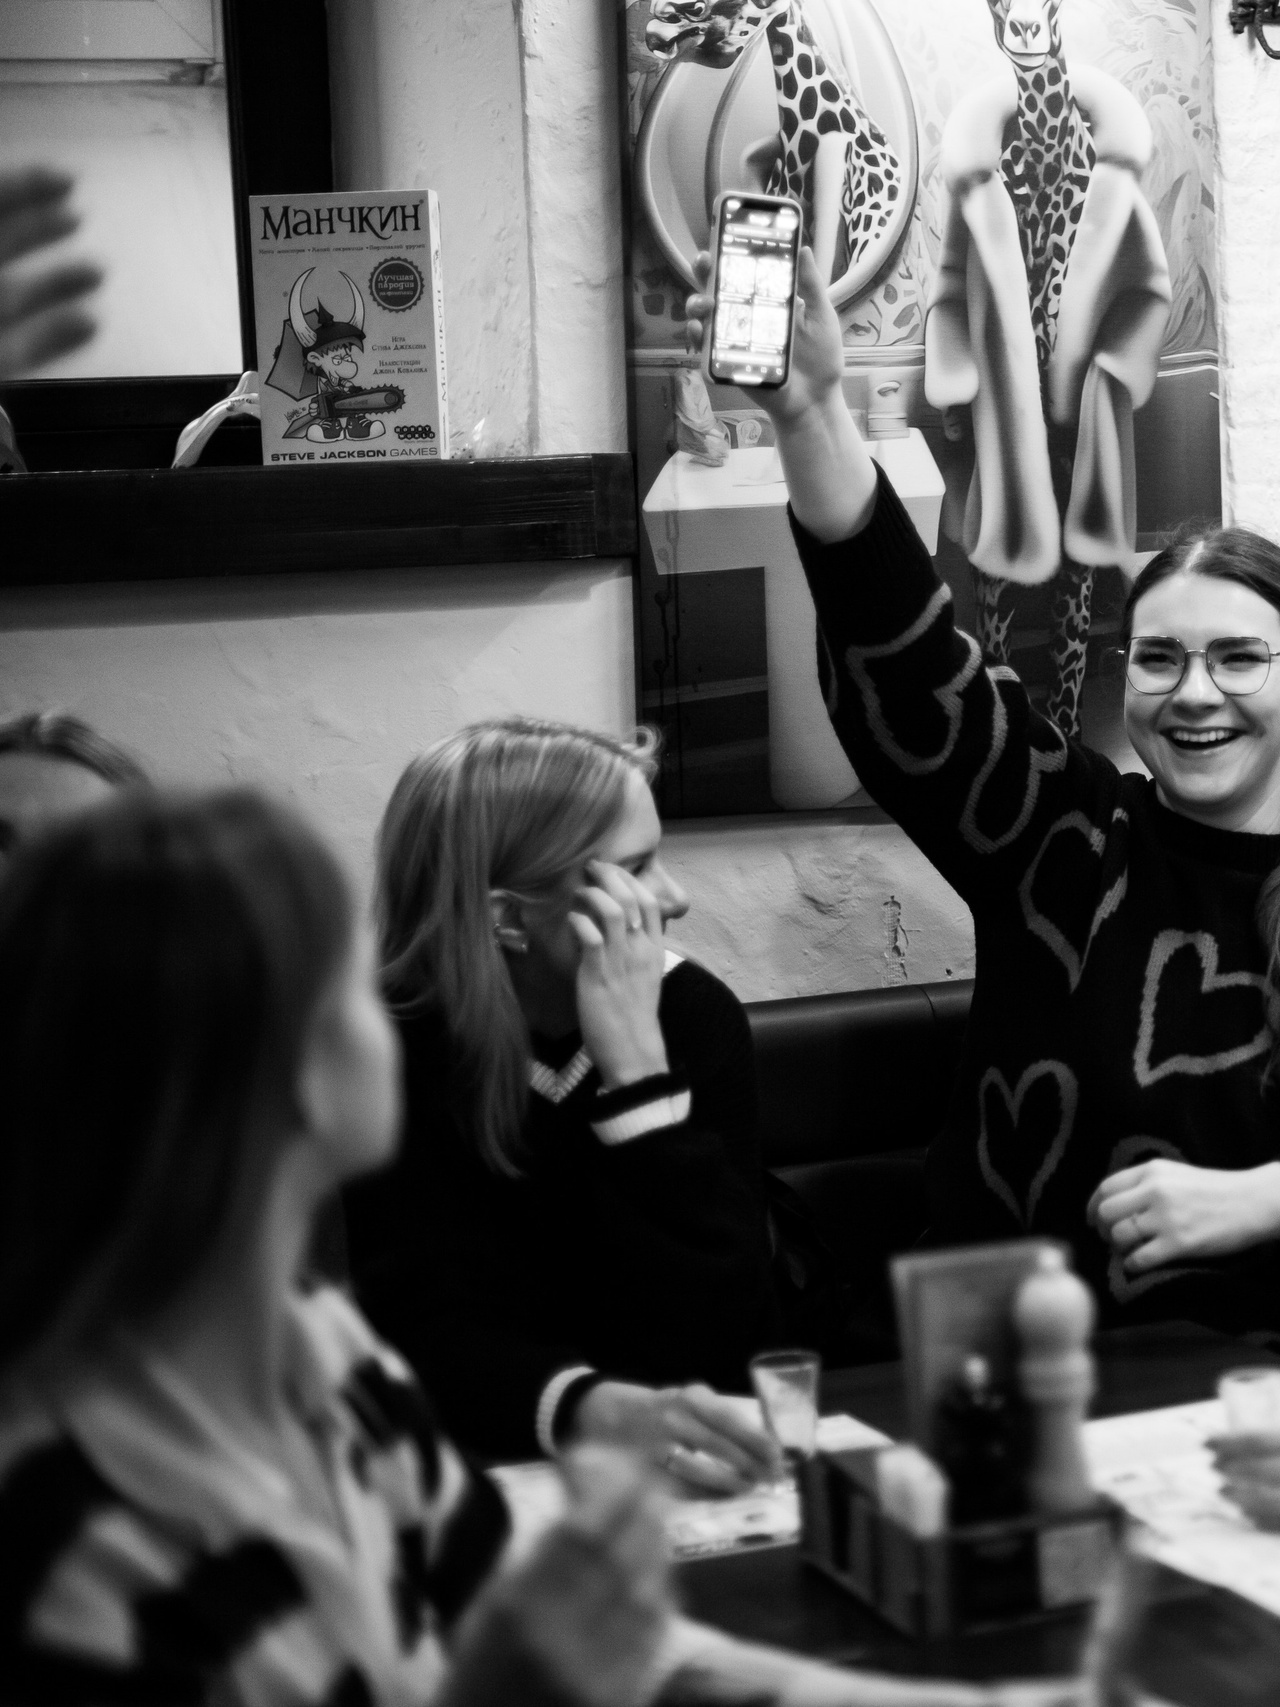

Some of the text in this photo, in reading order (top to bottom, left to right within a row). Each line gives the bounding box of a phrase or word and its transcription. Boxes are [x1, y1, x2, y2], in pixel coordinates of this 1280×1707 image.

[260, 204, 421, 241] Манчкин
[271, 447, 438, 462] STEVE JACKSON GAMES
